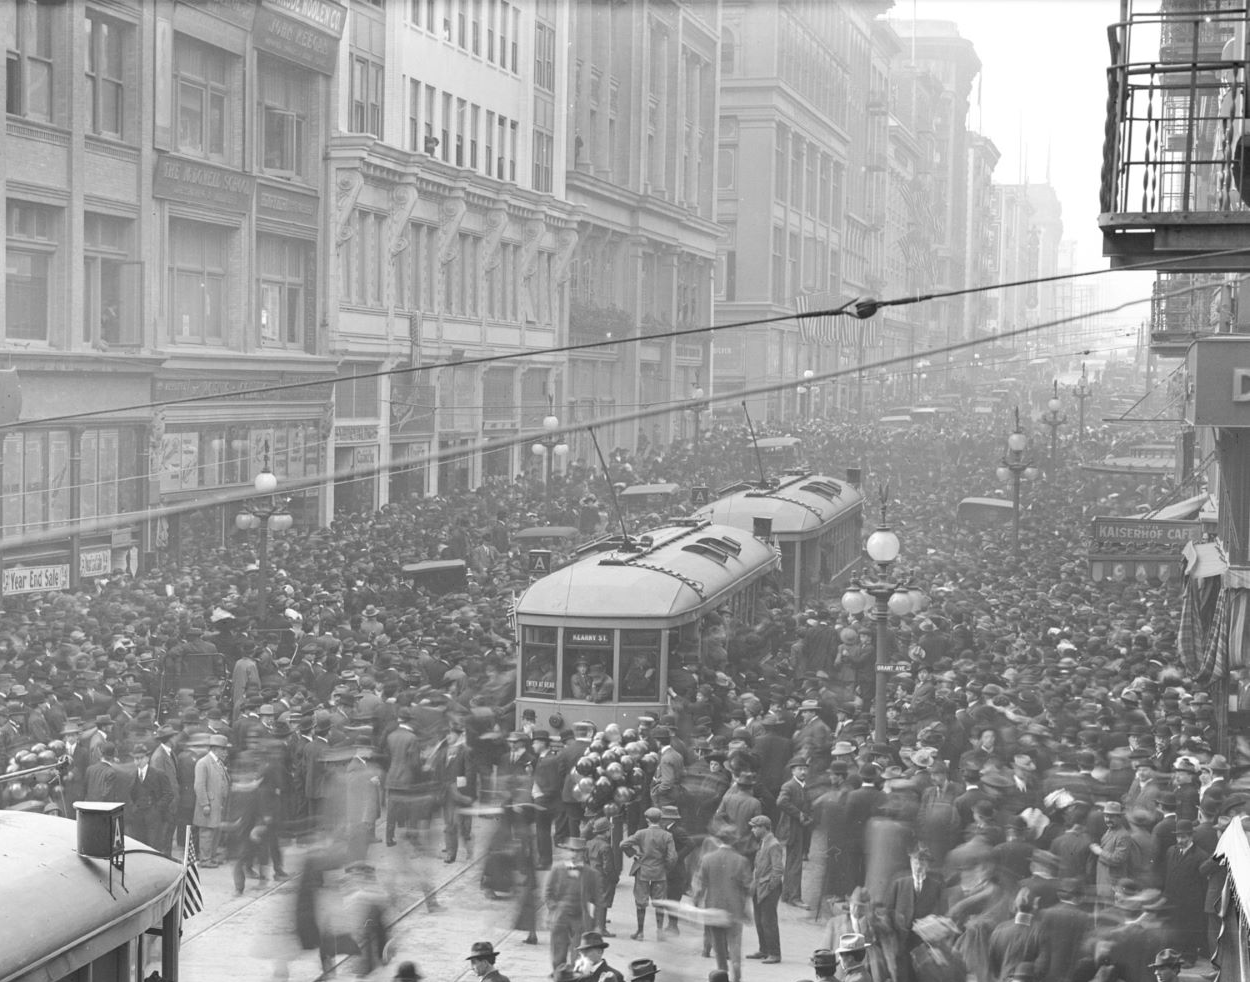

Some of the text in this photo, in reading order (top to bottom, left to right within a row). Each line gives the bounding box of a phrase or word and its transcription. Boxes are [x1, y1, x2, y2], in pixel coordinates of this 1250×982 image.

[1098, 525, 1164, 539] KAISERHOF
[533, 556, 546, 570] A
[11, 571, 27, 590] Year
[30, 569, 43, 588] End
[44, 568, 59, 586] Sale
[572, 633, 596, 641] KEARNY
